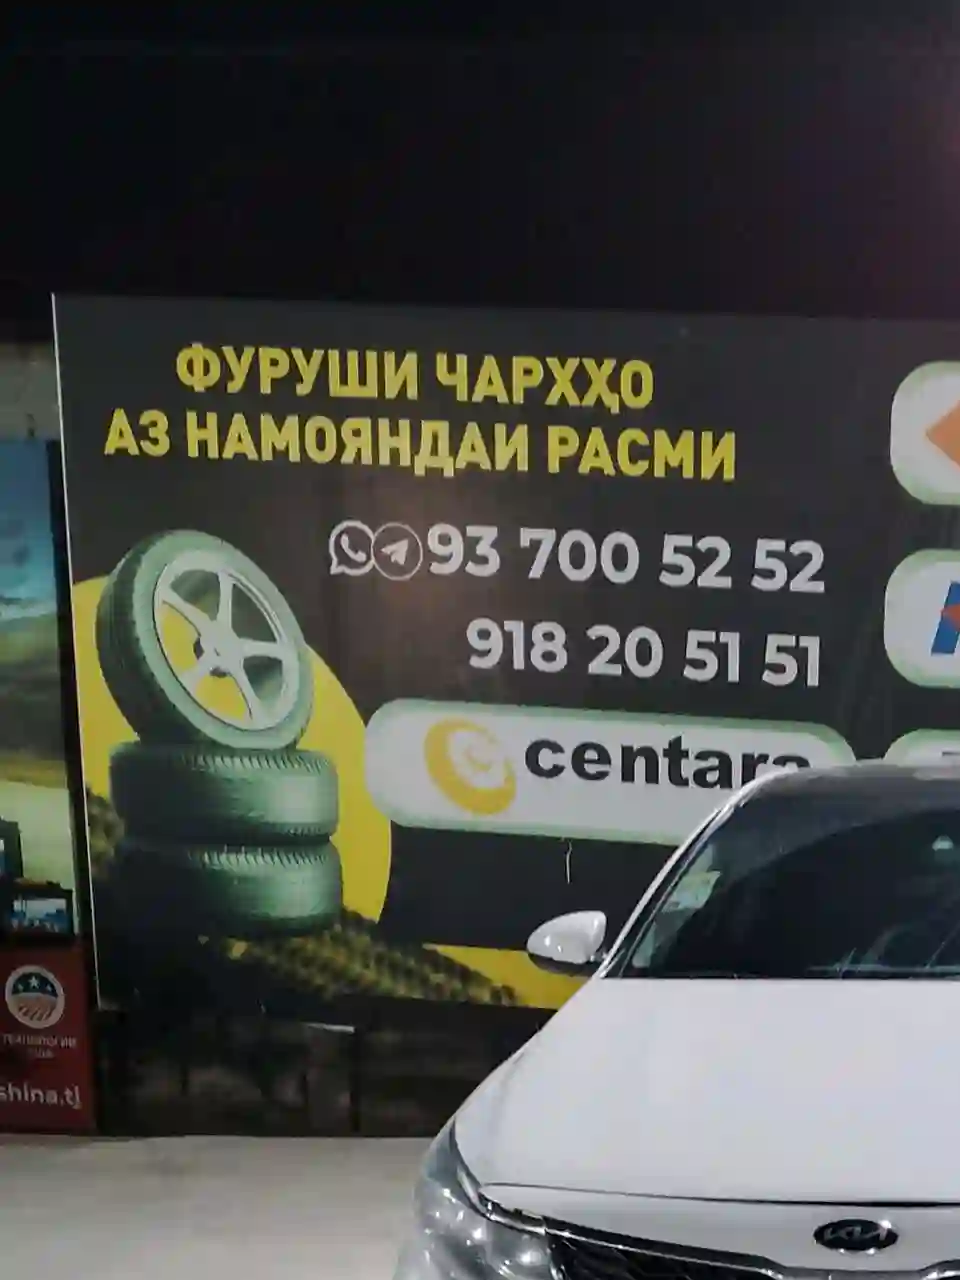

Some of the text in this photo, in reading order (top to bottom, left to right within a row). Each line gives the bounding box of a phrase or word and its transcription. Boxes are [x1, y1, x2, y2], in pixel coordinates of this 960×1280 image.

[175, 342, 655, 414] ФУРУШИ ЧАРХҲО
[104, 408, 736, 481] АЗ НАМОЯНДАИ РАСМИ
[427, 523, 825, 593] 93 700 52 52
[466, 617, 821, 688] 918 20 51 51
